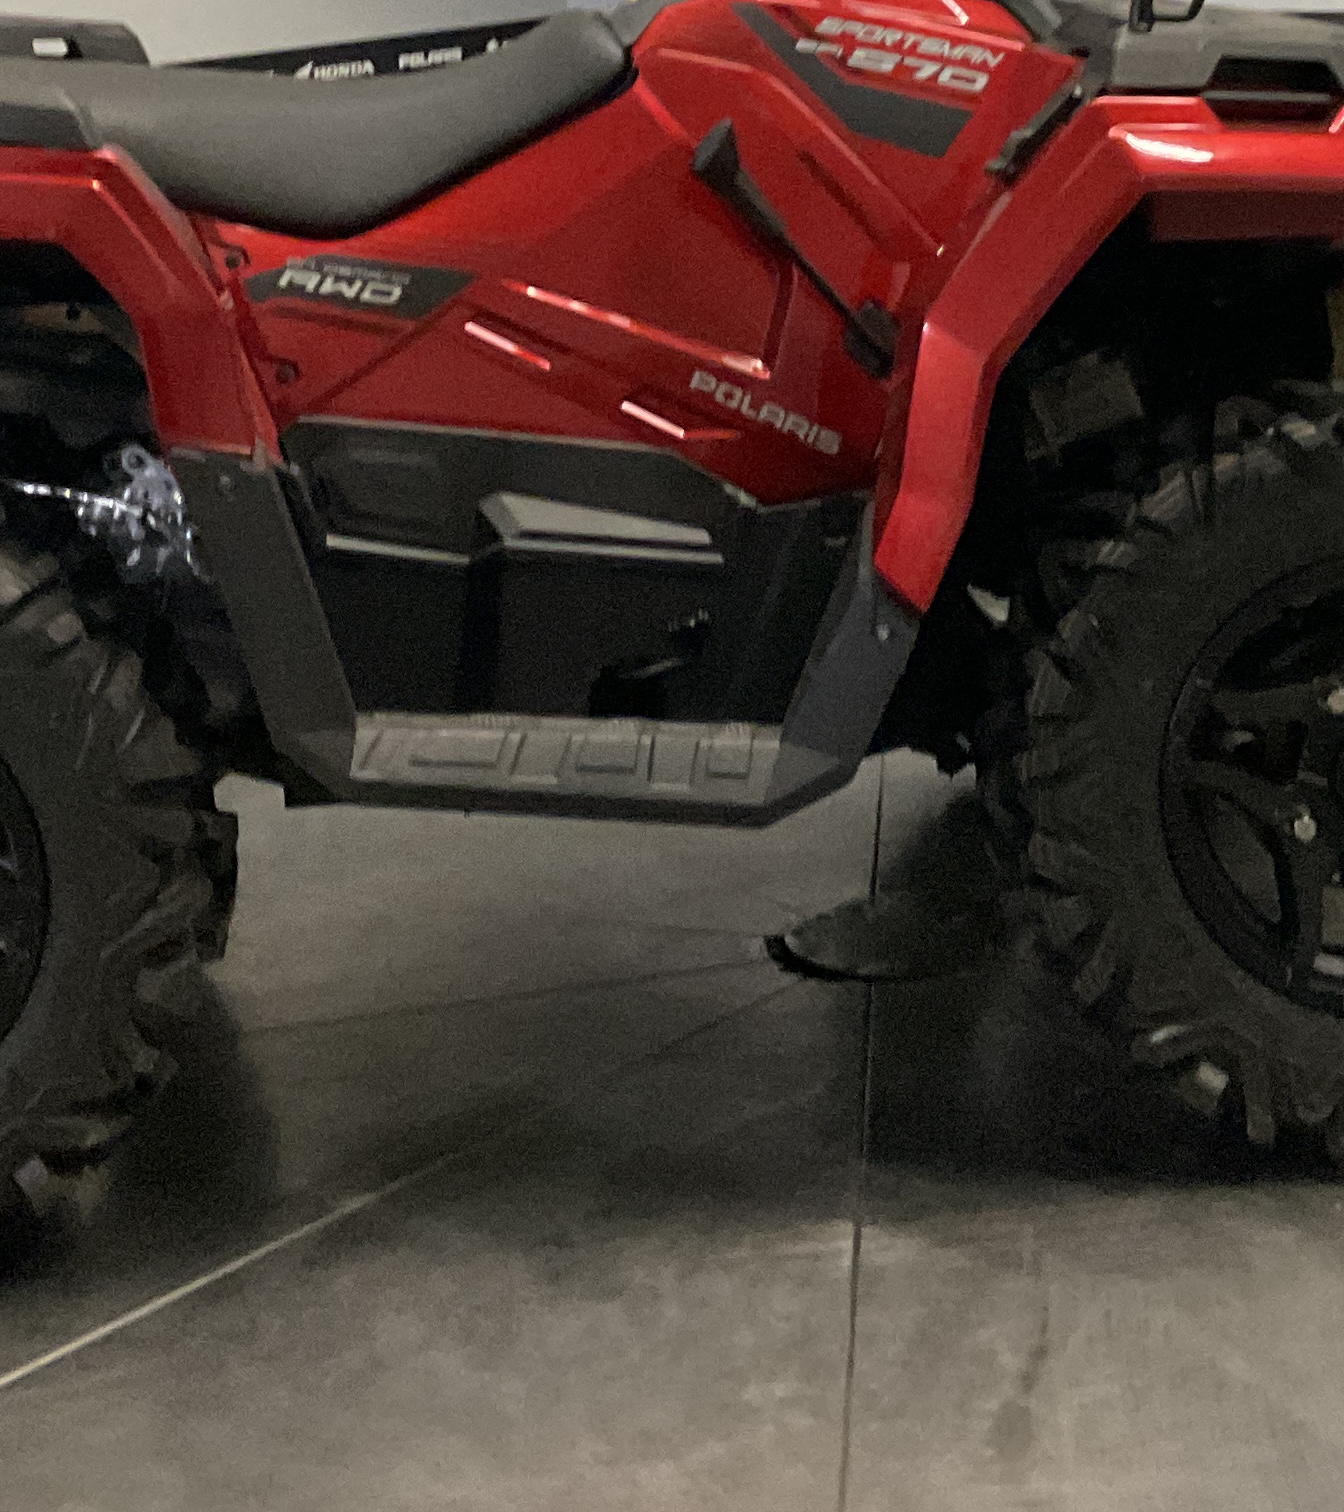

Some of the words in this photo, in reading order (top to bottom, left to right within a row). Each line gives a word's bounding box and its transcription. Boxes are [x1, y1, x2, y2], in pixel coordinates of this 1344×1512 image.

[814, 15, 1006, 68] SPORTSMAN
[277, 268, 404, 305] AWD
[689, 370, 843, 456] POLARIS
